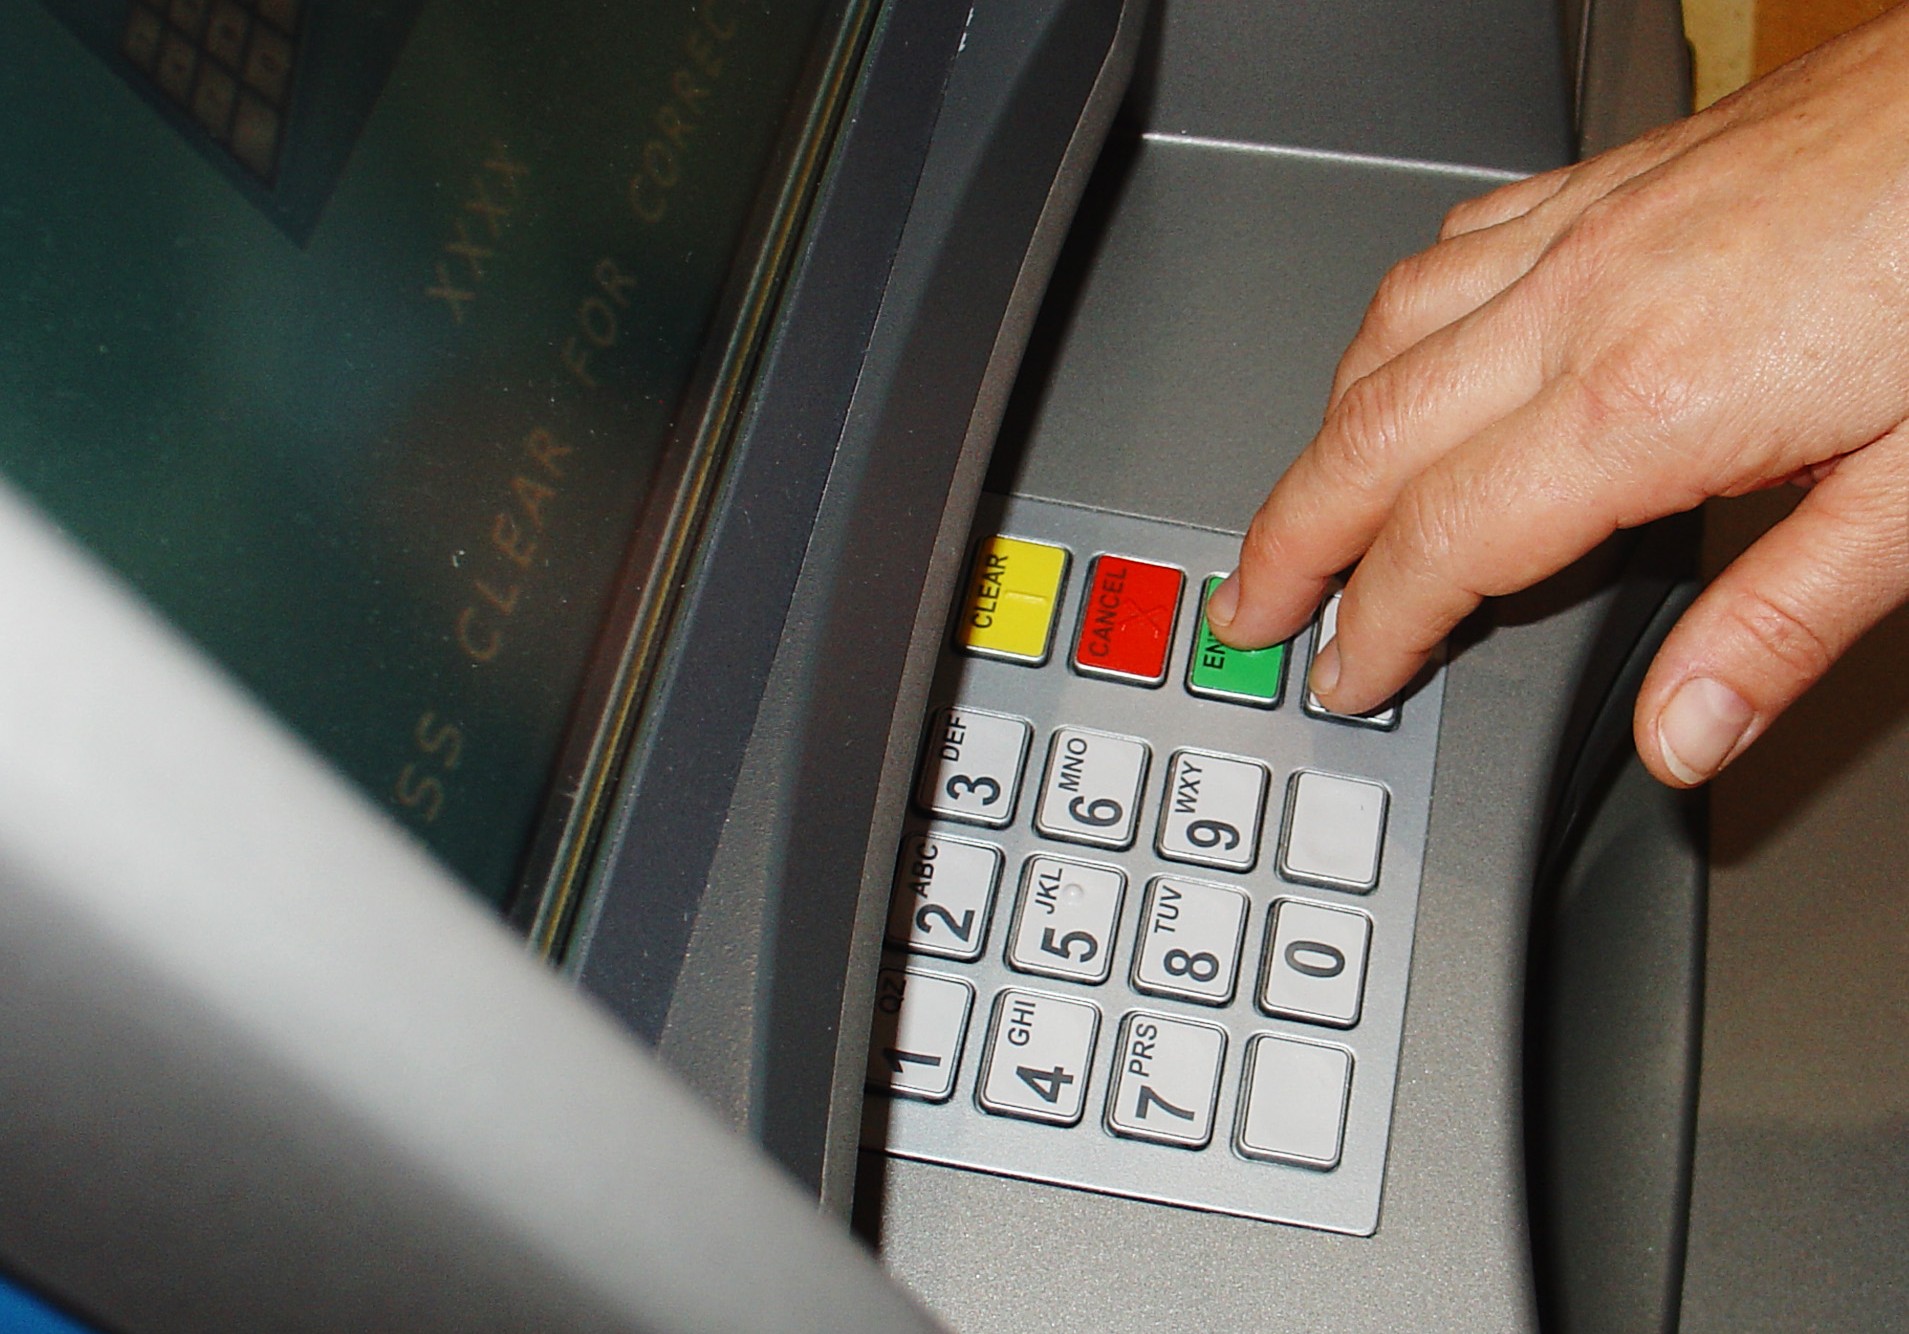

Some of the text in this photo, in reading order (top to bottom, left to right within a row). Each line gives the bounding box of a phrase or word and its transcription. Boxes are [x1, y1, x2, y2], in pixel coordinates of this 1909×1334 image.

[424, 141, 530, 325] XXXX
[456, 427, 574, 662] CLEAR
[560, 258, 637, 389] FOR
[970, 553, 1008, 629] CLEAR
[1089, 568, 1127, 657] CANCEL
[1202, 630, 1226, 670] EN
[938, 715, 1001, 807] 3 DEF
[1058, 738, 1123, 828] 6 MNO
[1175, 761, 1241, 852] 9 WXY
[911, 842, 975, 943] 2 ABC
[1034, 868, 1099, 964] 5 JKL
[1154, 887, 1220, 983] 8 TUV
[1284, 939, 1346, 979] 0
[877, 976, 942, 1074] 1 QZ
[1007, 1000, 1075, 1104] 4 GHI
[1128, 1022, 1196, 1123] 7 PRS
